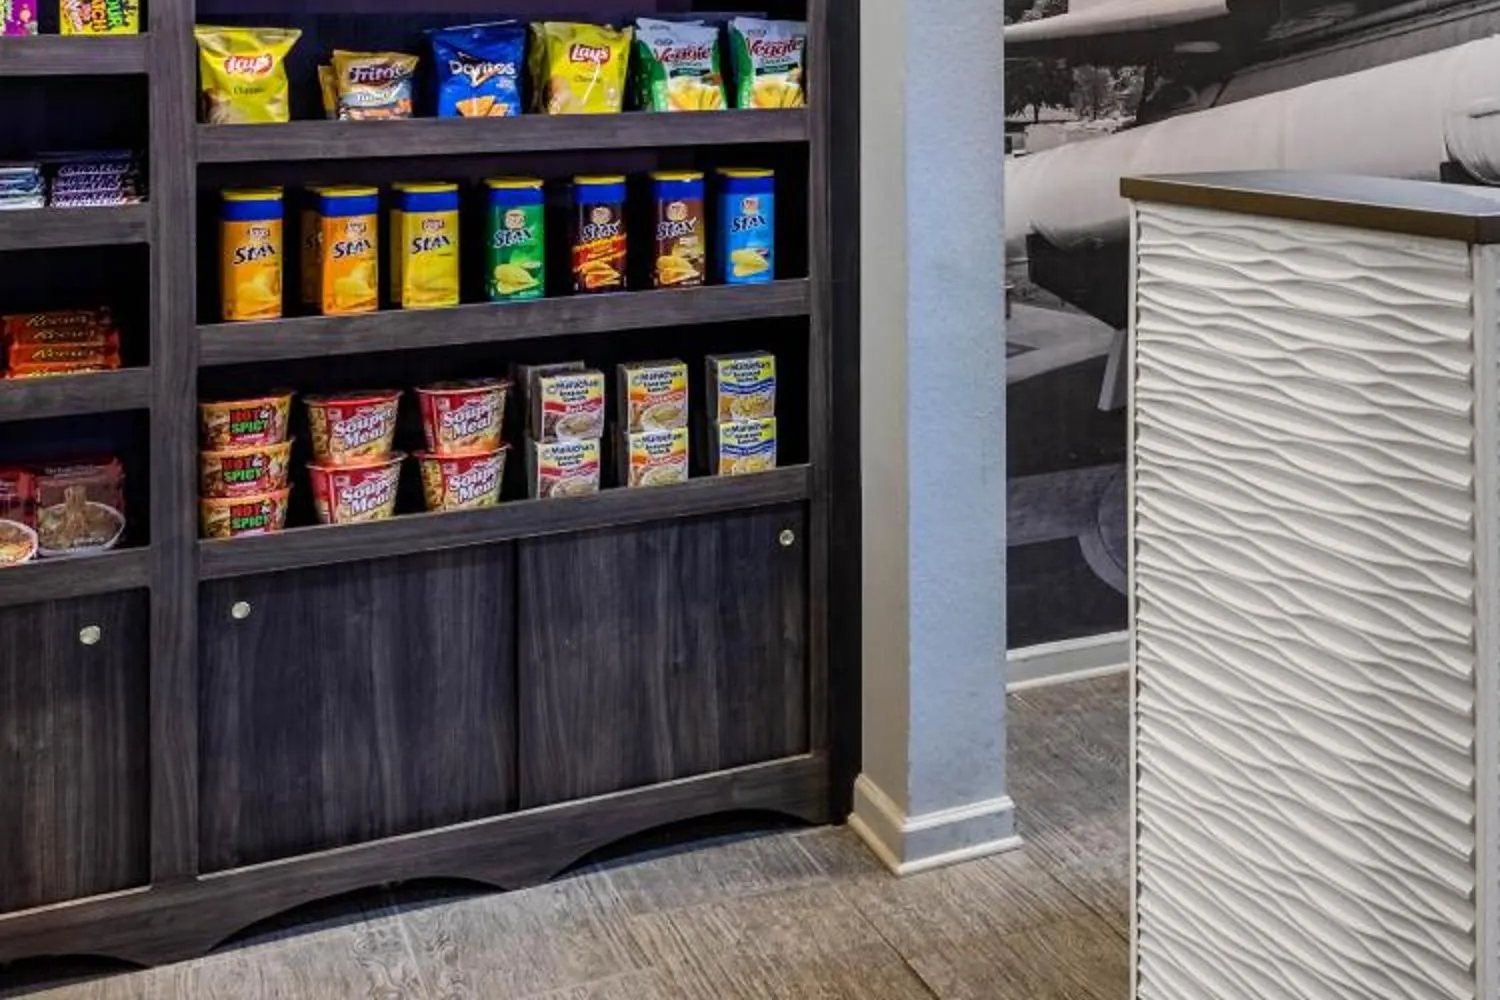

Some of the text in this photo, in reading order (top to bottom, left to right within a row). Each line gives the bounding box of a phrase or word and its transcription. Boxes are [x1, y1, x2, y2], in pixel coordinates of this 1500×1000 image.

[571, 42, 609, 64] Lay's
[350, 64, 402, 83] Fritos
[449, 59, 516, 77] Doritos
